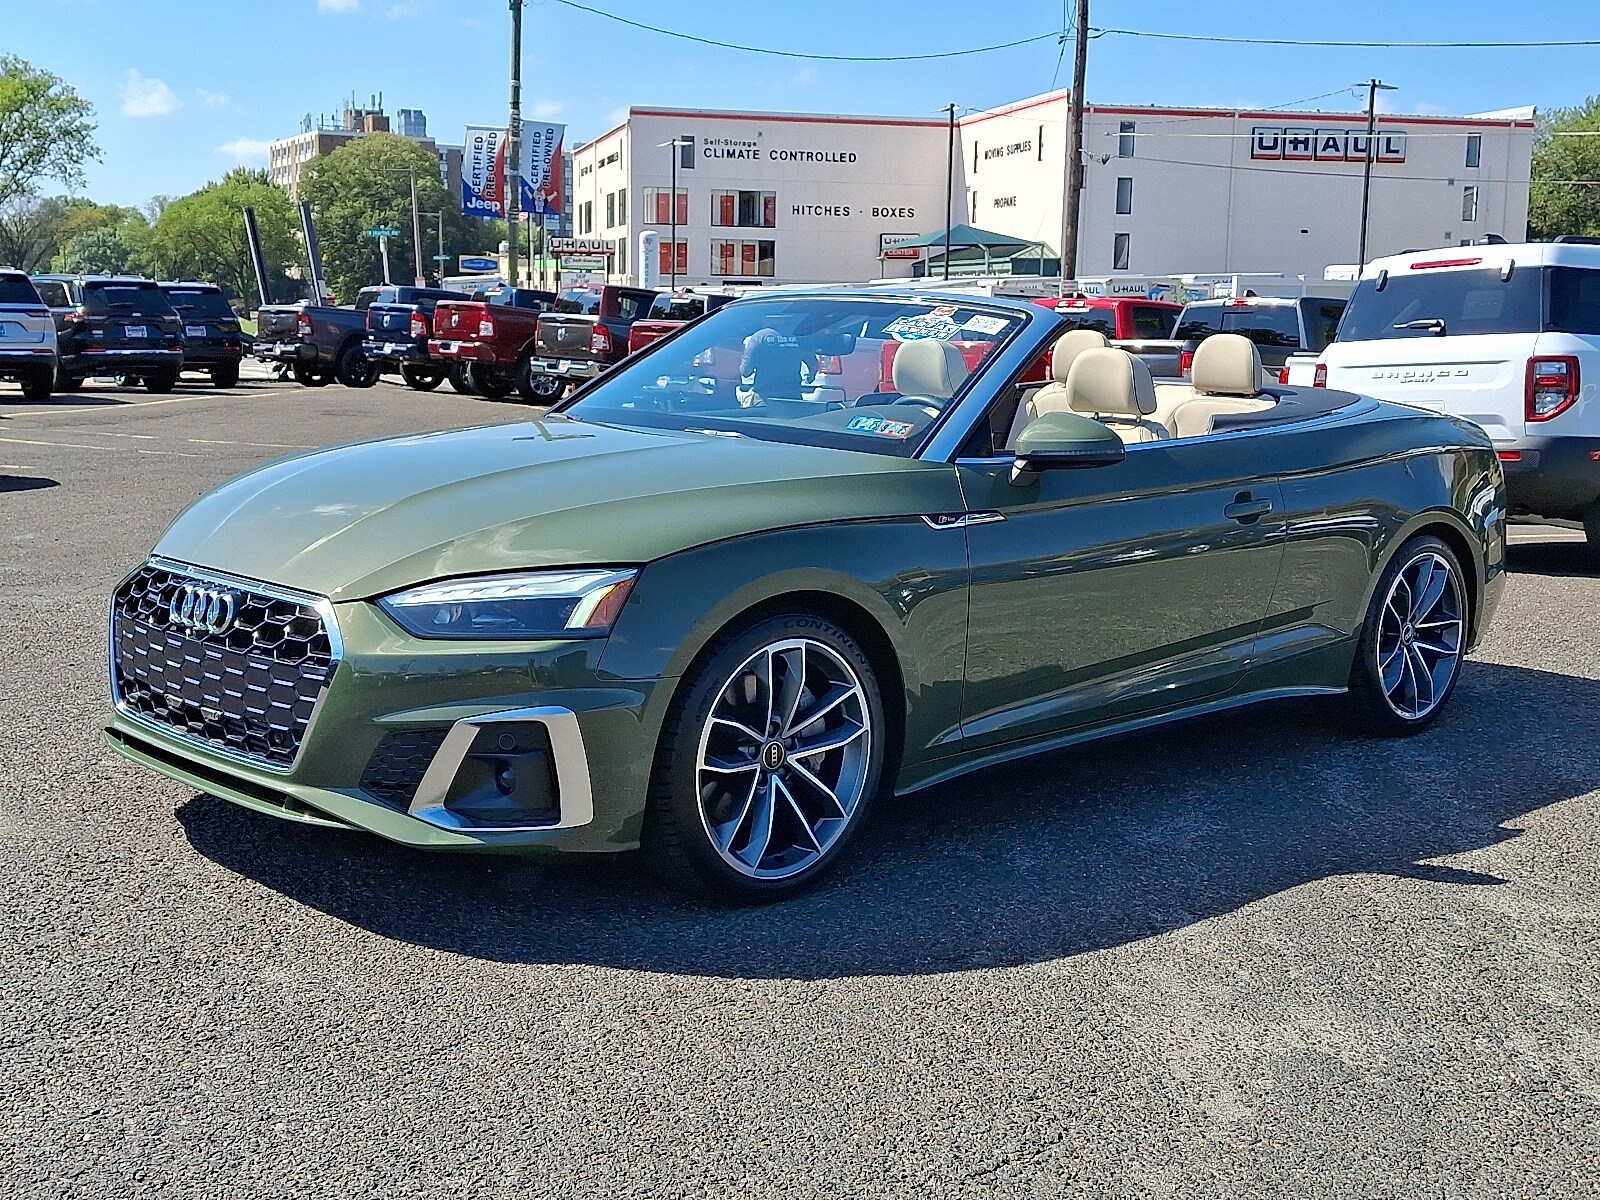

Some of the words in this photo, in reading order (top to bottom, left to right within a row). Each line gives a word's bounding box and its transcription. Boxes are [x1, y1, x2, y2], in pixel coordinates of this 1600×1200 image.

[703, 138, 757, 147] Self-Storage
[984, 146, 1004, 160] MOVING
[1006, 140, 1032, 156] SUPPLIES
[531, 131, 541, 185] CERTIFIED
[543, 127, 554, 187] PRE-OWNED
[703, 147, 761, 160] CLIMATE
[769, 150, 857, 163] CONTROLLED
[471, 136, 484, 195] CERTIFIED
[486, 132, 497, 198] PRE-OWNED
[466, 196, 501, 213] Jeep
[993, 195, 1017, 209] PROPANE
[792, 205, 851, 216] HITCHES
[871, 207, 915, 218] BOXES
[1371, 369, 1469, 379] BRONCO
